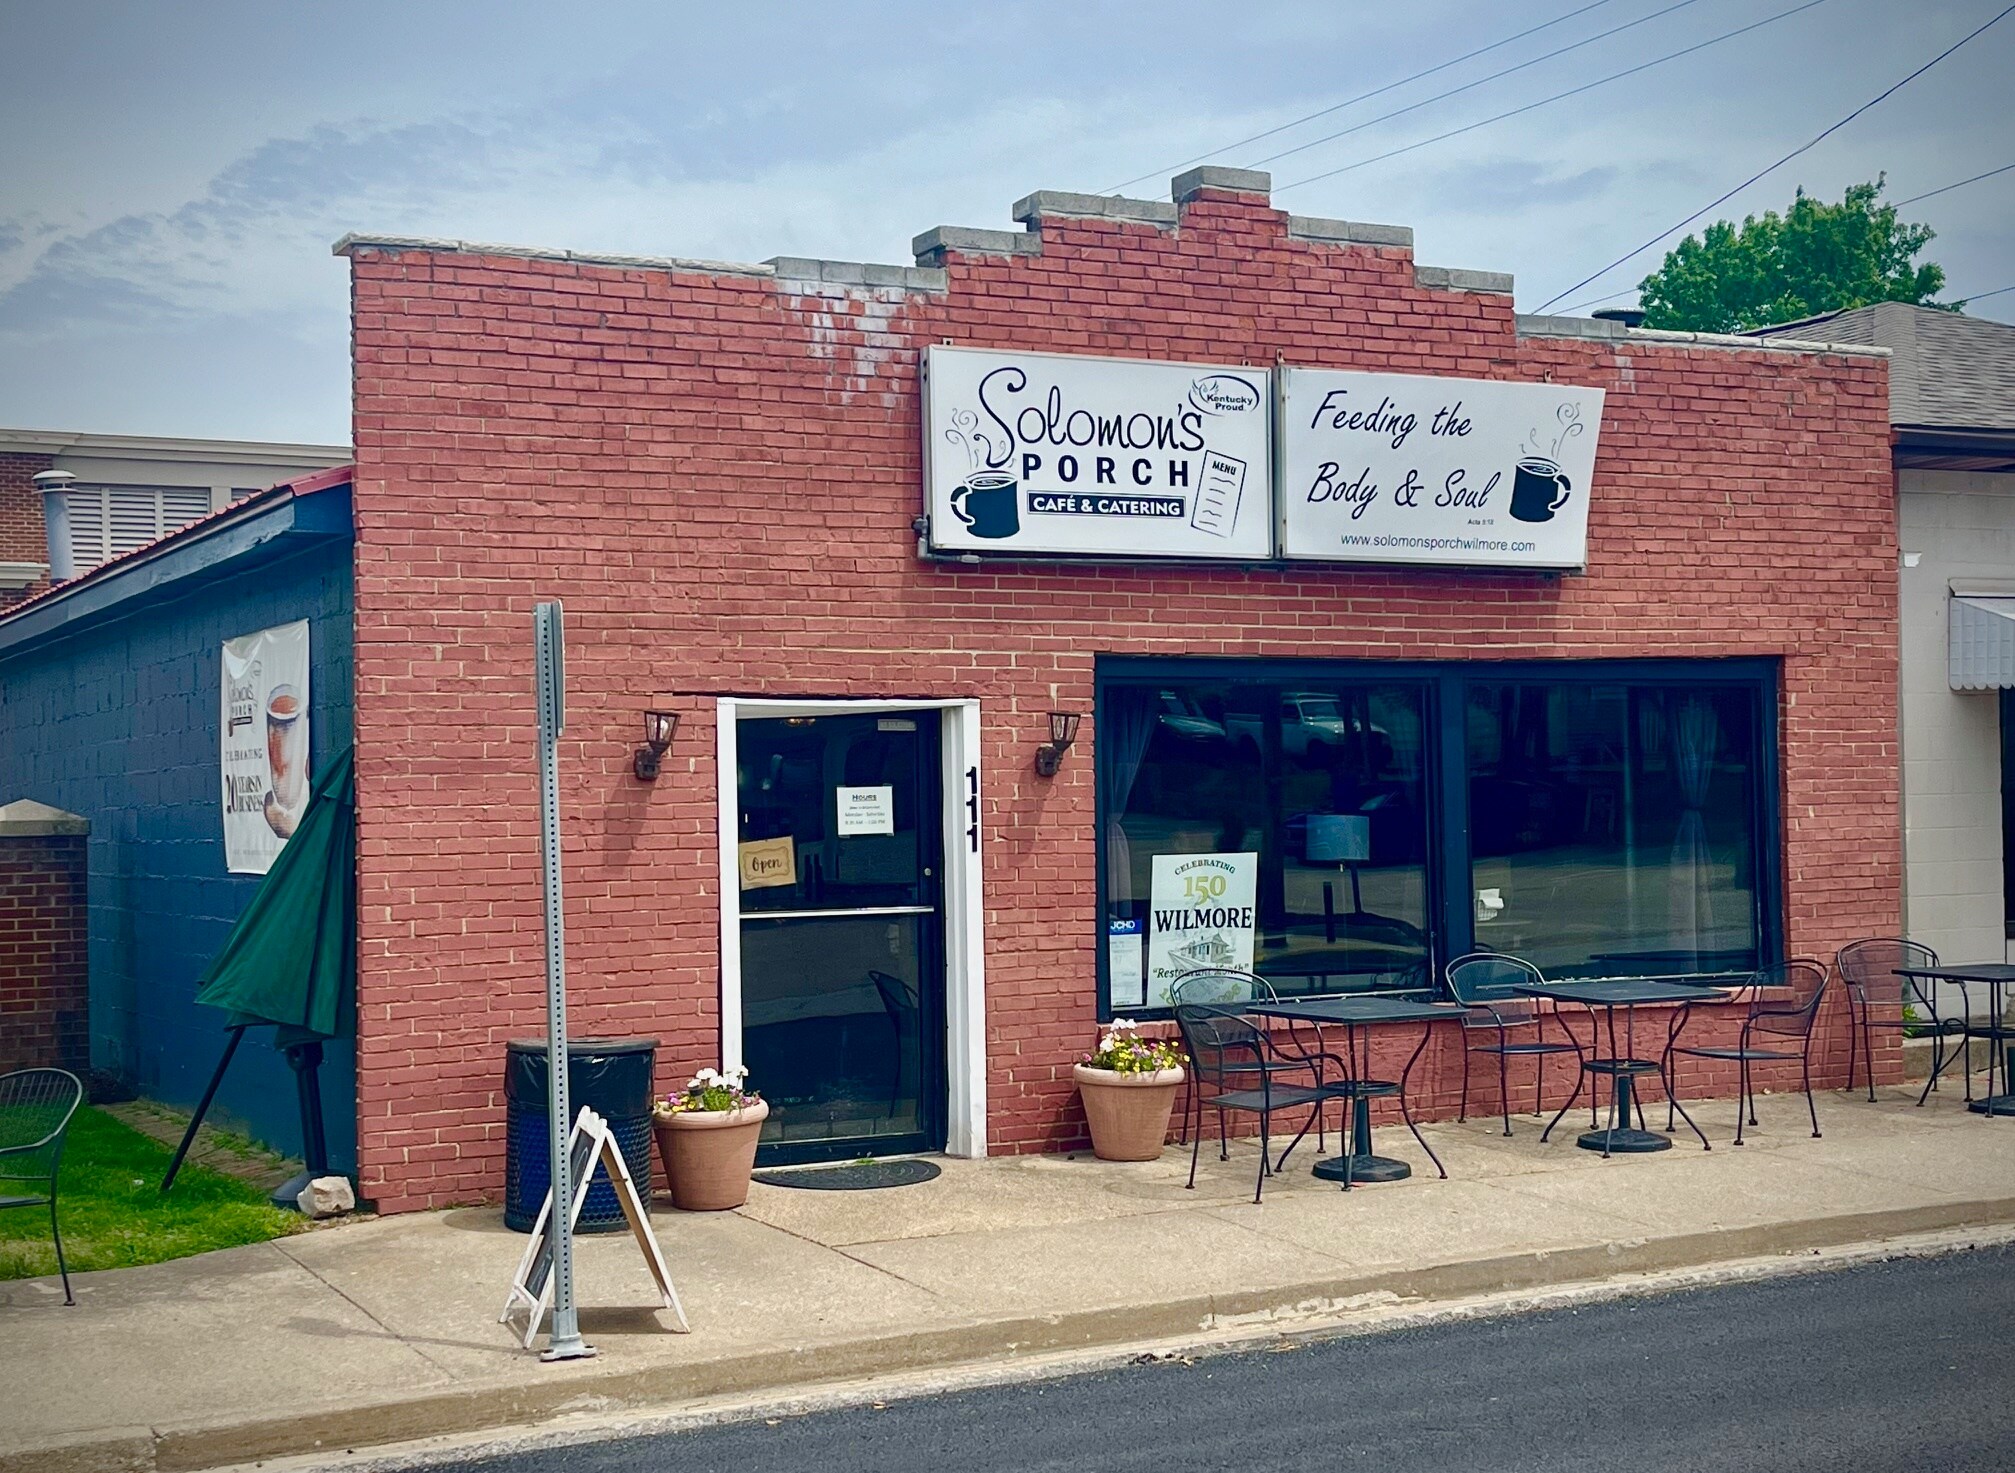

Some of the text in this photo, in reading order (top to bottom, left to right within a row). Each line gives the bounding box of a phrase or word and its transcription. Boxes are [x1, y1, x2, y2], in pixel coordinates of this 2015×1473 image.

[1206, 394, 1253, 406] Kentucky
[1215, 403, 1244, 411] Proud
[1310, 389, 1472, 449] Feeding the
[1021, 453, 1189, 487] PORCH
[1212, 461, 1237, 475] MENU
[1307, 461, 1502, 520] Body & Soul
[1033, 494, 1181, 516] CAFÉ & CATERING
[1341, 533, 1535, 552] www.solomonsporchwilmore.com
[752, 857, 783, 872] Open
[1174, 859, 1236, 875] CELEBRATING
[1183, 875, 1227, 906] 150
[1154, 907, 1252, 933] WILMORE
